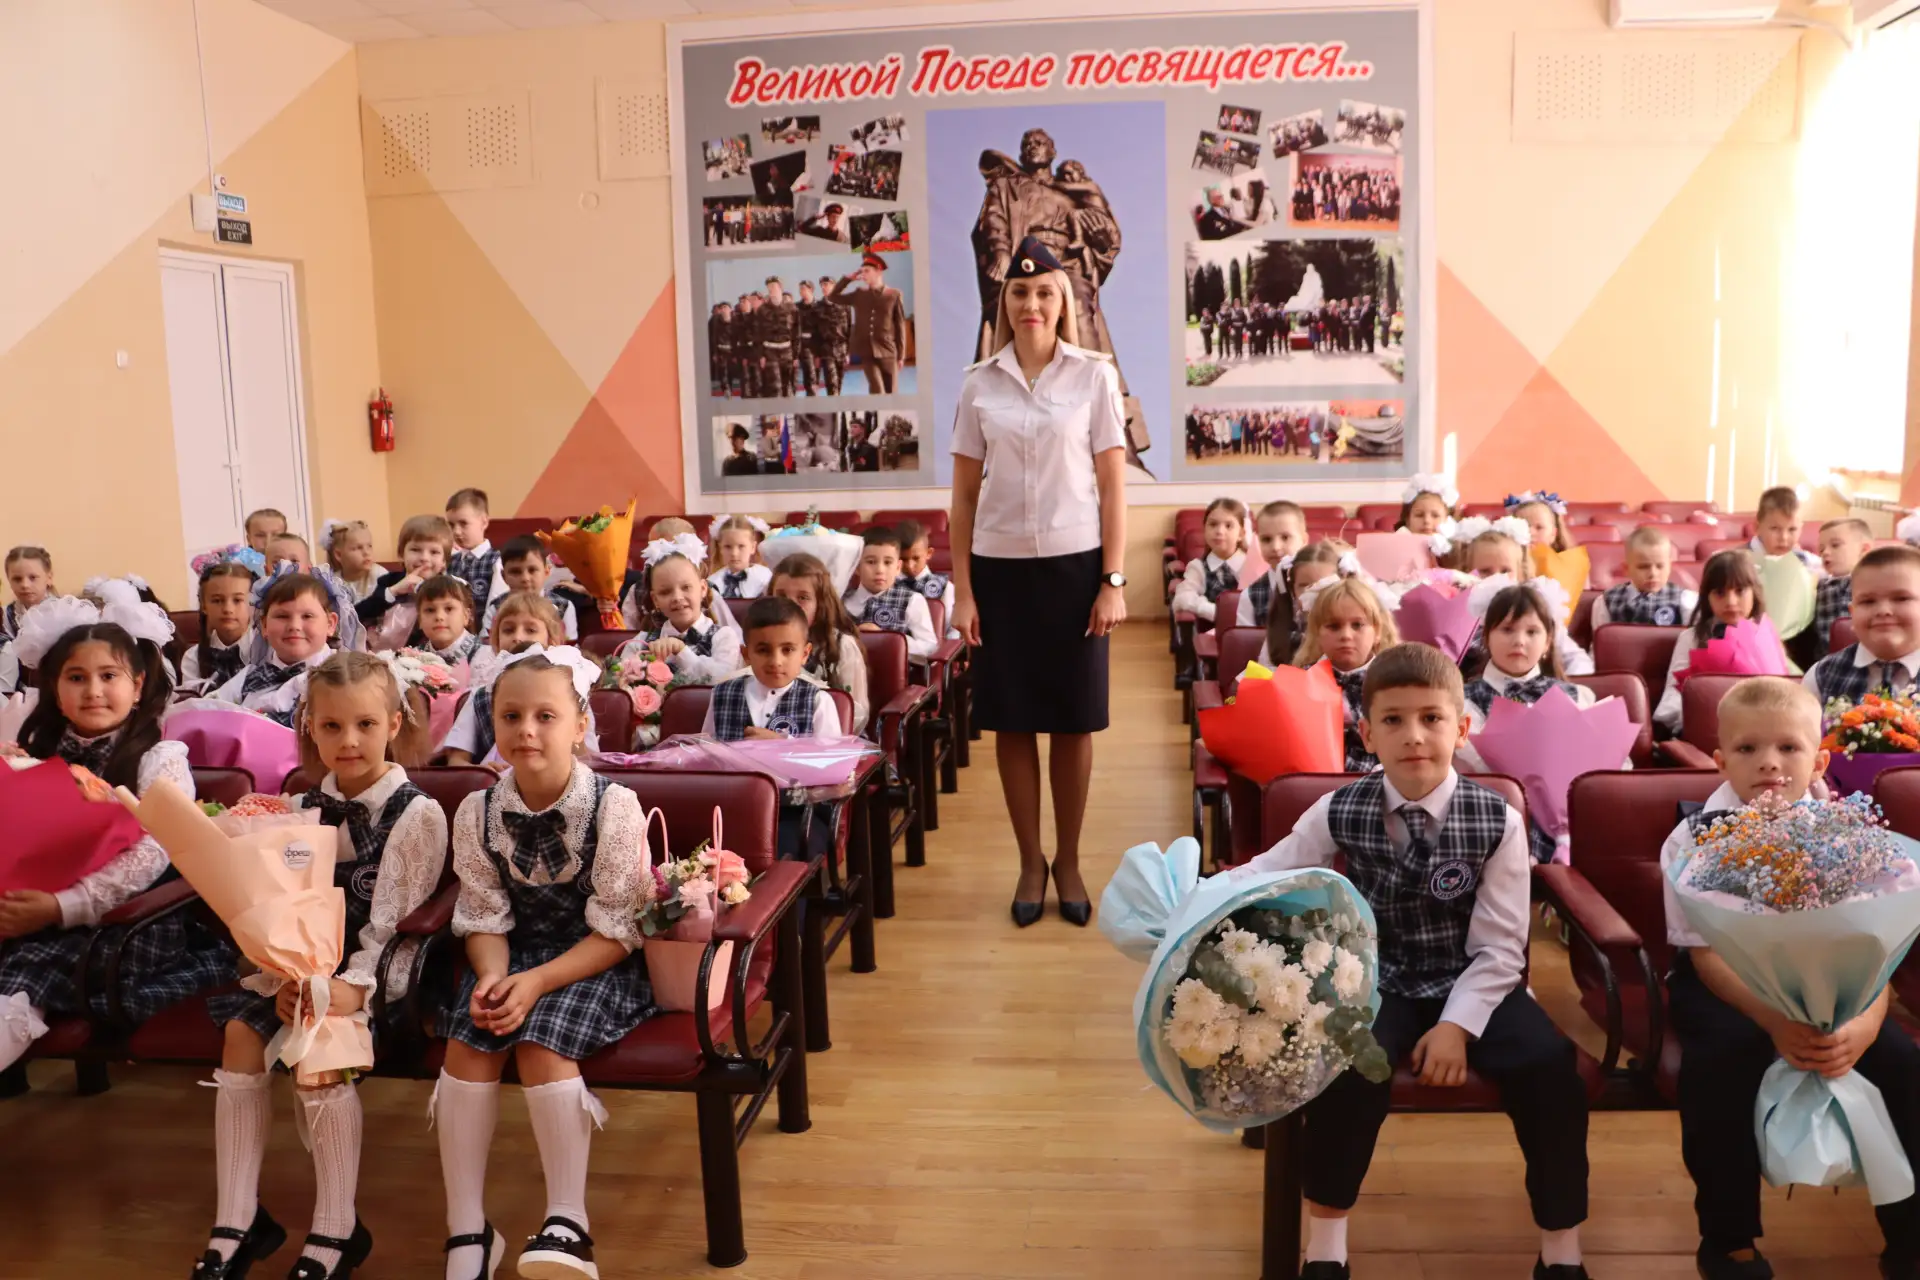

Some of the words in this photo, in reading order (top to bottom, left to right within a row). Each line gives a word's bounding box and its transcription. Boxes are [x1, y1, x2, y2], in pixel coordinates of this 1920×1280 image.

[729, 55, 902, 104] Великой
[911, 48, 1055, 93] Победе
[1066, 45, 1370, 88] посвящается...
[219, 196, 243, 210] ВЫХОД
[221, 220, 247, 234] ВЫХОД
[227, 231, 242, 240] EXIT
[285, 847, 310, 858] фреш
